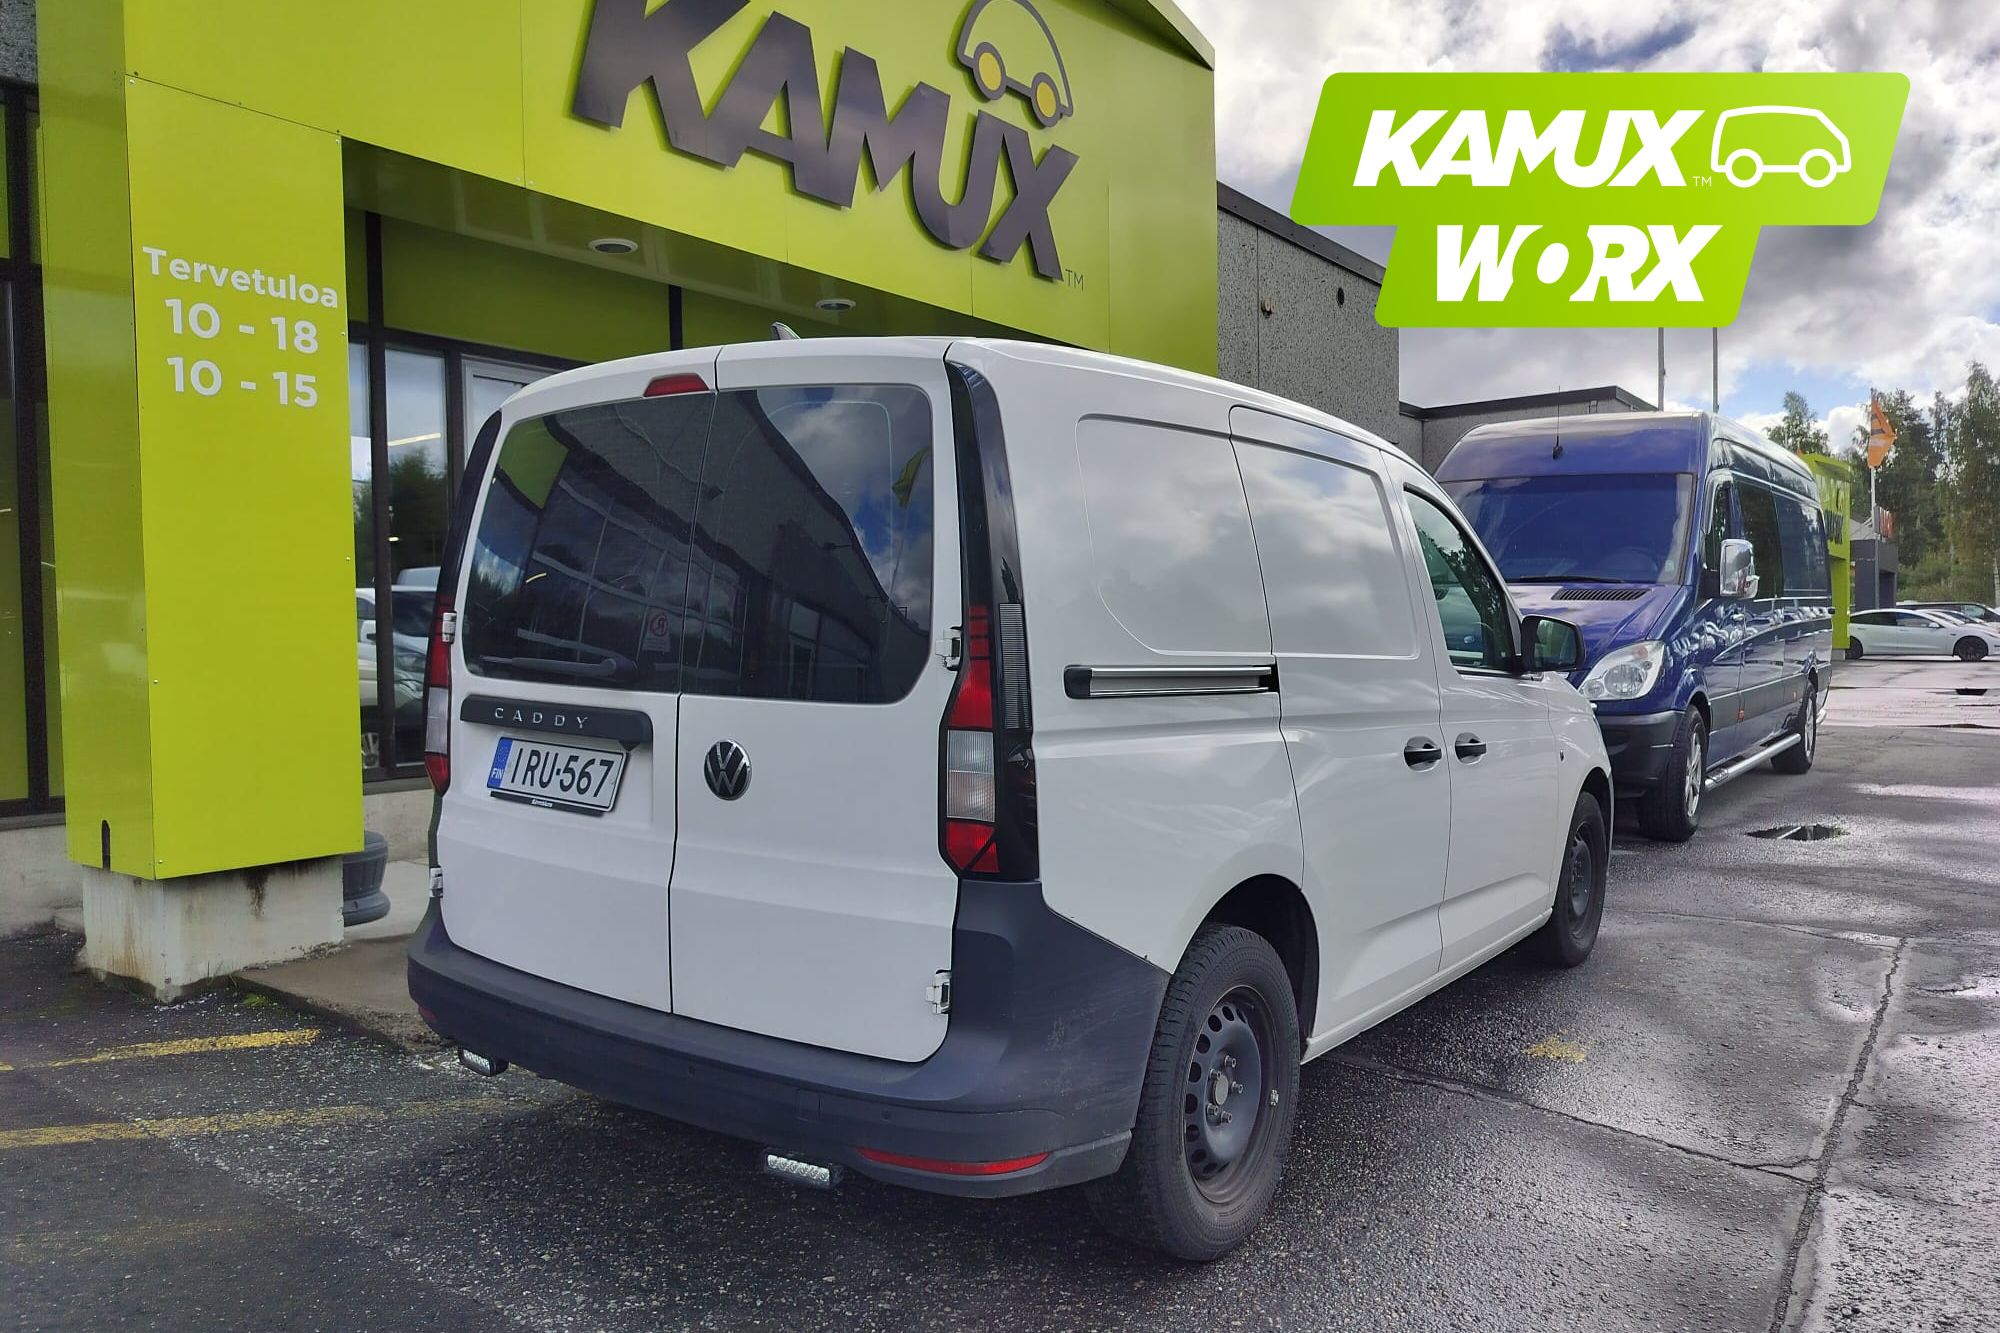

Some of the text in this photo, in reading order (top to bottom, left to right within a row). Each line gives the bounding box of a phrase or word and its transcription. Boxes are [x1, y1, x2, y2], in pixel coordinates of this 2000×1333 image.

[573, 0, 1079, 281] KAMUX
[142, 246, 338, 308] Tervetuloa
[165, 298, 319, 354] 10 - 18
[167, 357, 318, 407] 10 - 15
[494, 707, 588, 729] CADDY
[510, 747, 615, 798] IRU-567
